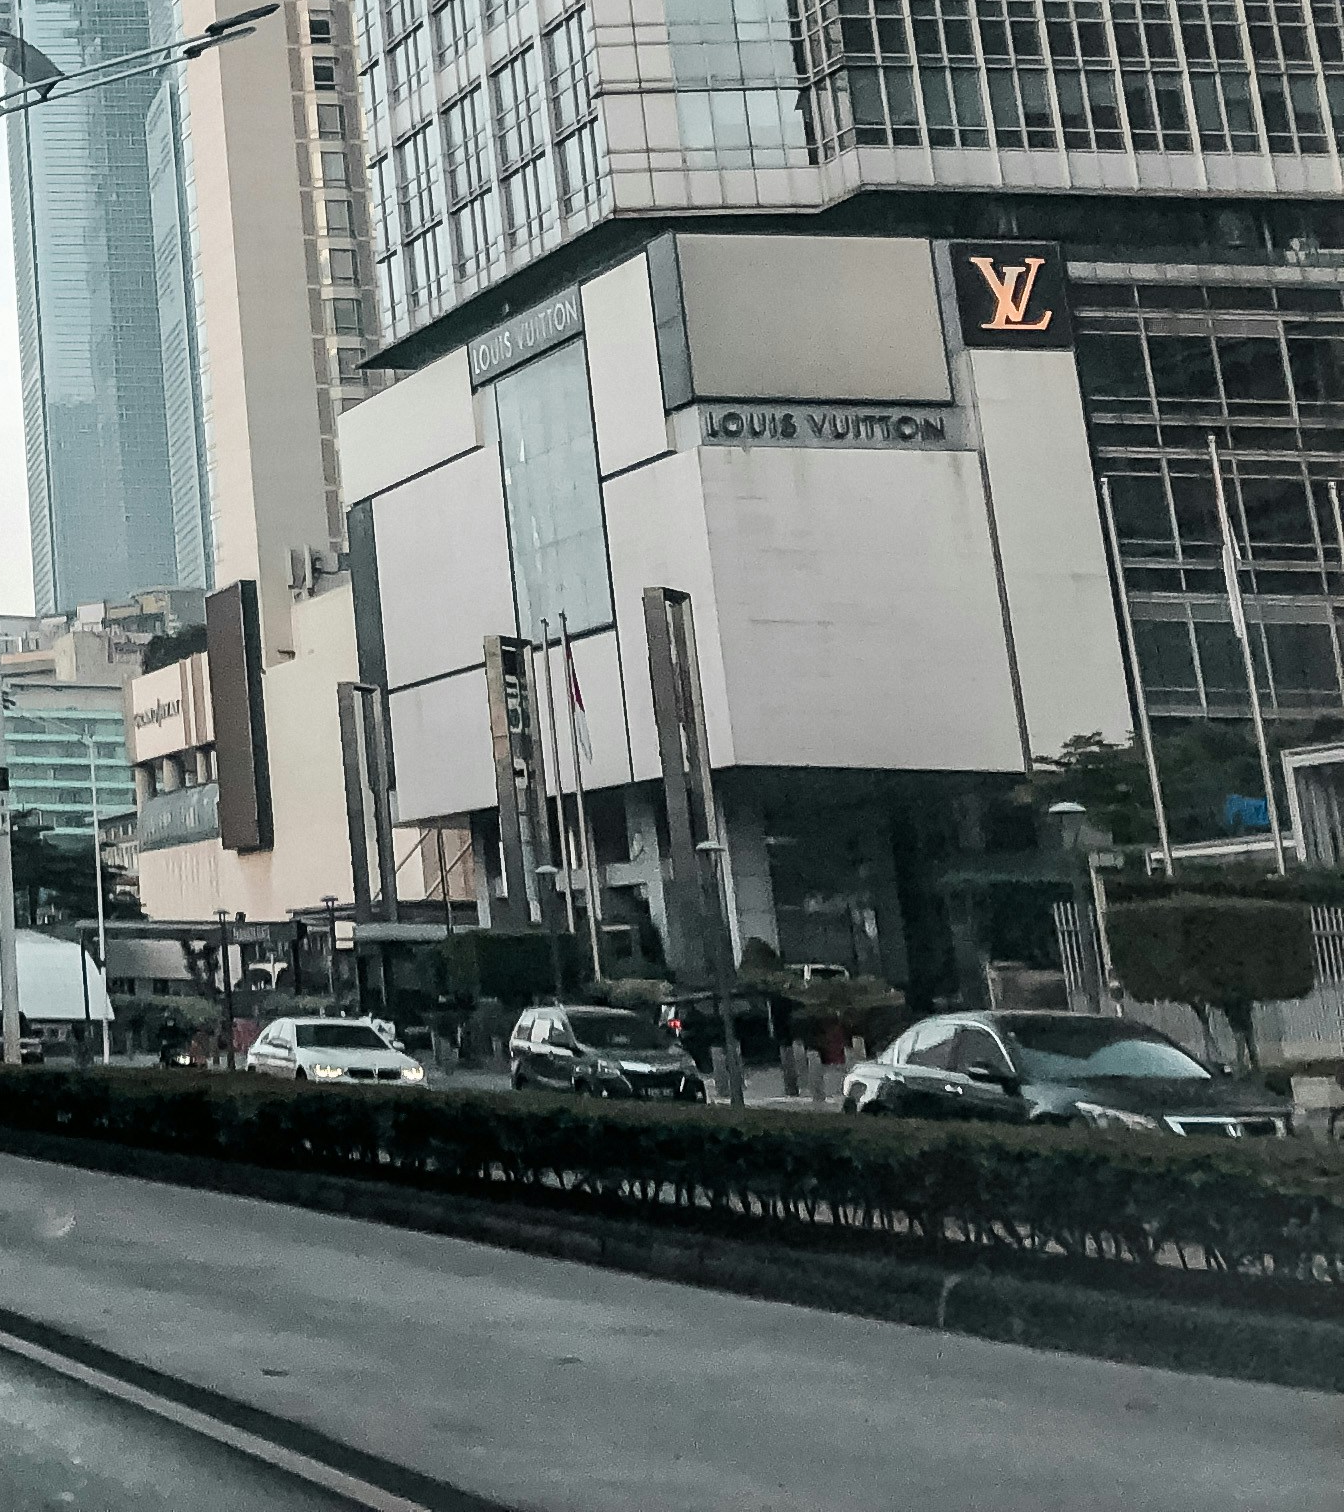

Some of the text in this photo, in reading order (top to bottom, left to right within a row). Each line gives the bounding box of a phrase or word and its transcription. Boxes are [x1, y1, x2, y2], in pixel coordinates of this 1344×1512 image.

[472, 294, 579, 375] LOUIS VUITTON
[705, 411, 948, 443] LOUIS VUITTON
